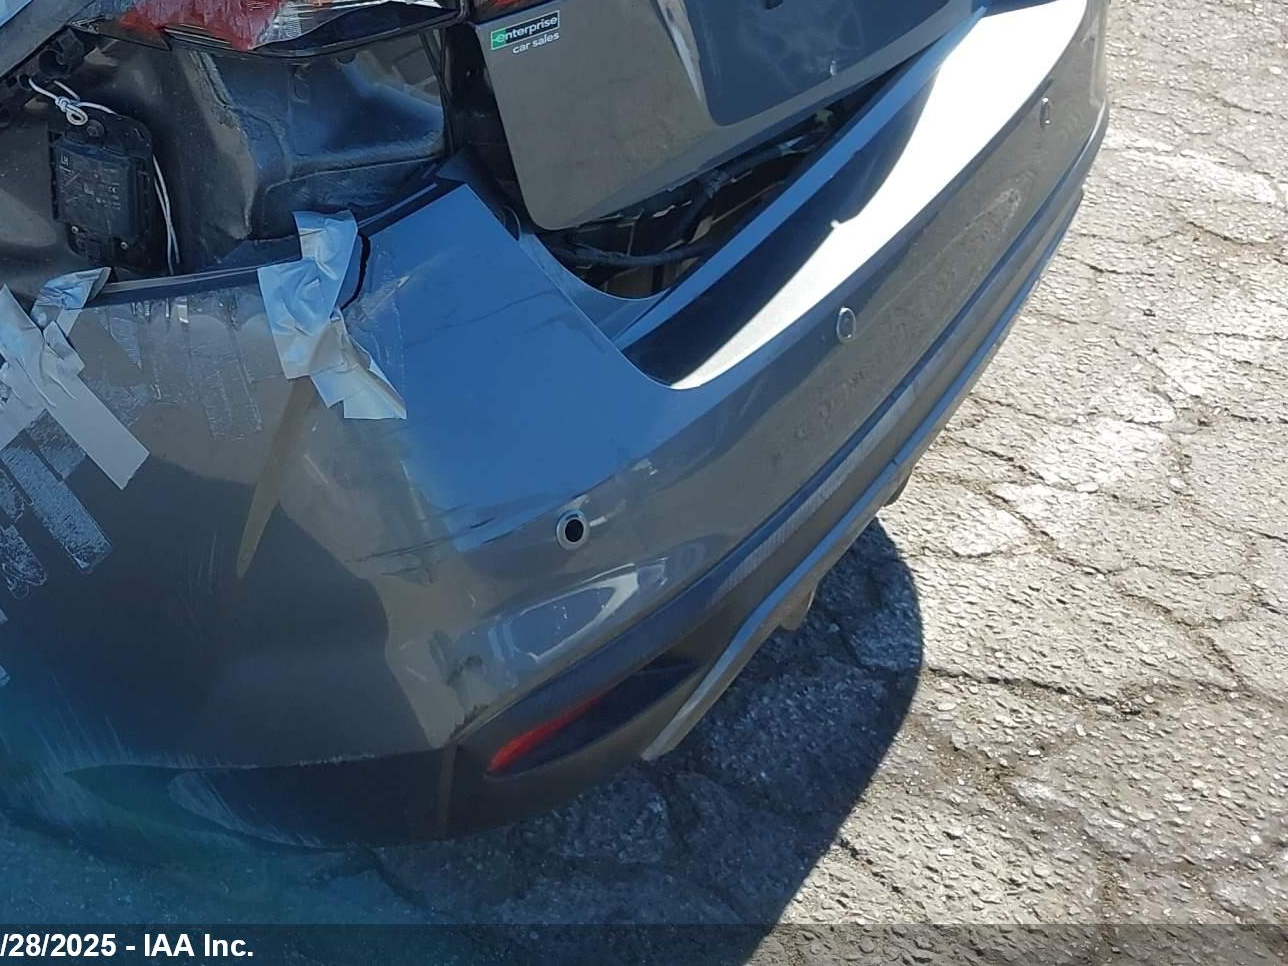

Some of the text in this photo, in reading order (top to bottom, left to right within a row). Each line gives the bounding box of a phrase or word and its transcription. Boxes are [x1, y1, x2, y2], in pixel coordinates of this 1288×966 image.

[494, 17, 558, 43] enterprise
[512, 32, 559, 54] car sales
